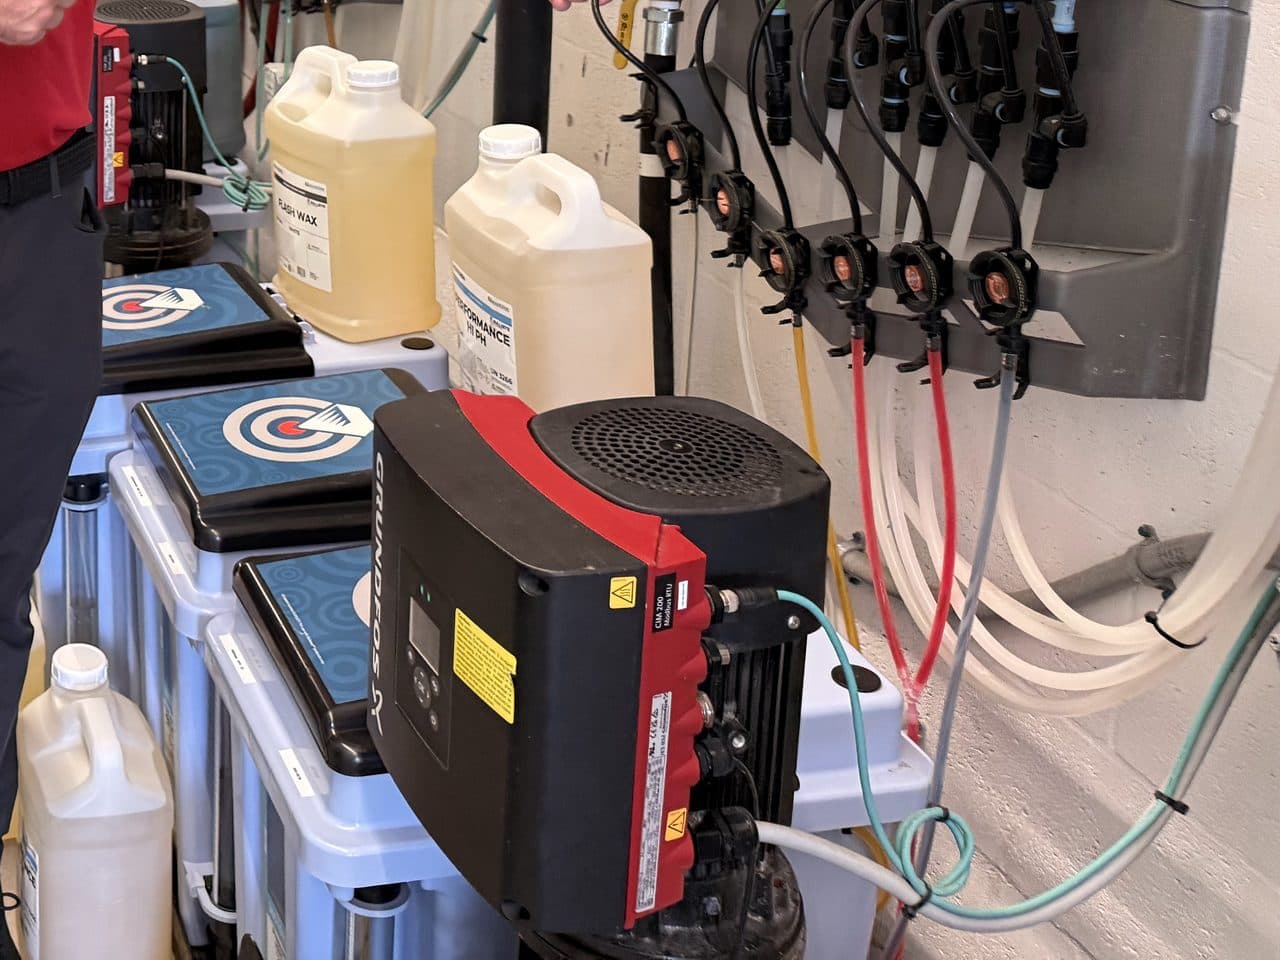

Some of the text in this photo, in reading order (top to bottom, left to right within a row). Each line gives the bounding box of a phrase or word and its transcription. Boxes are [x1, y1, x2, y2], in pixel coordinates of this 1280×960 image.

[296, 210, 318, 227] WAX
[466, 320, 475, 336] HI
[475, 328, 487, 347] PH
[372, 451, 384, 680] GRUNDFOS
[654, 596, 664, 629] CIM 200
